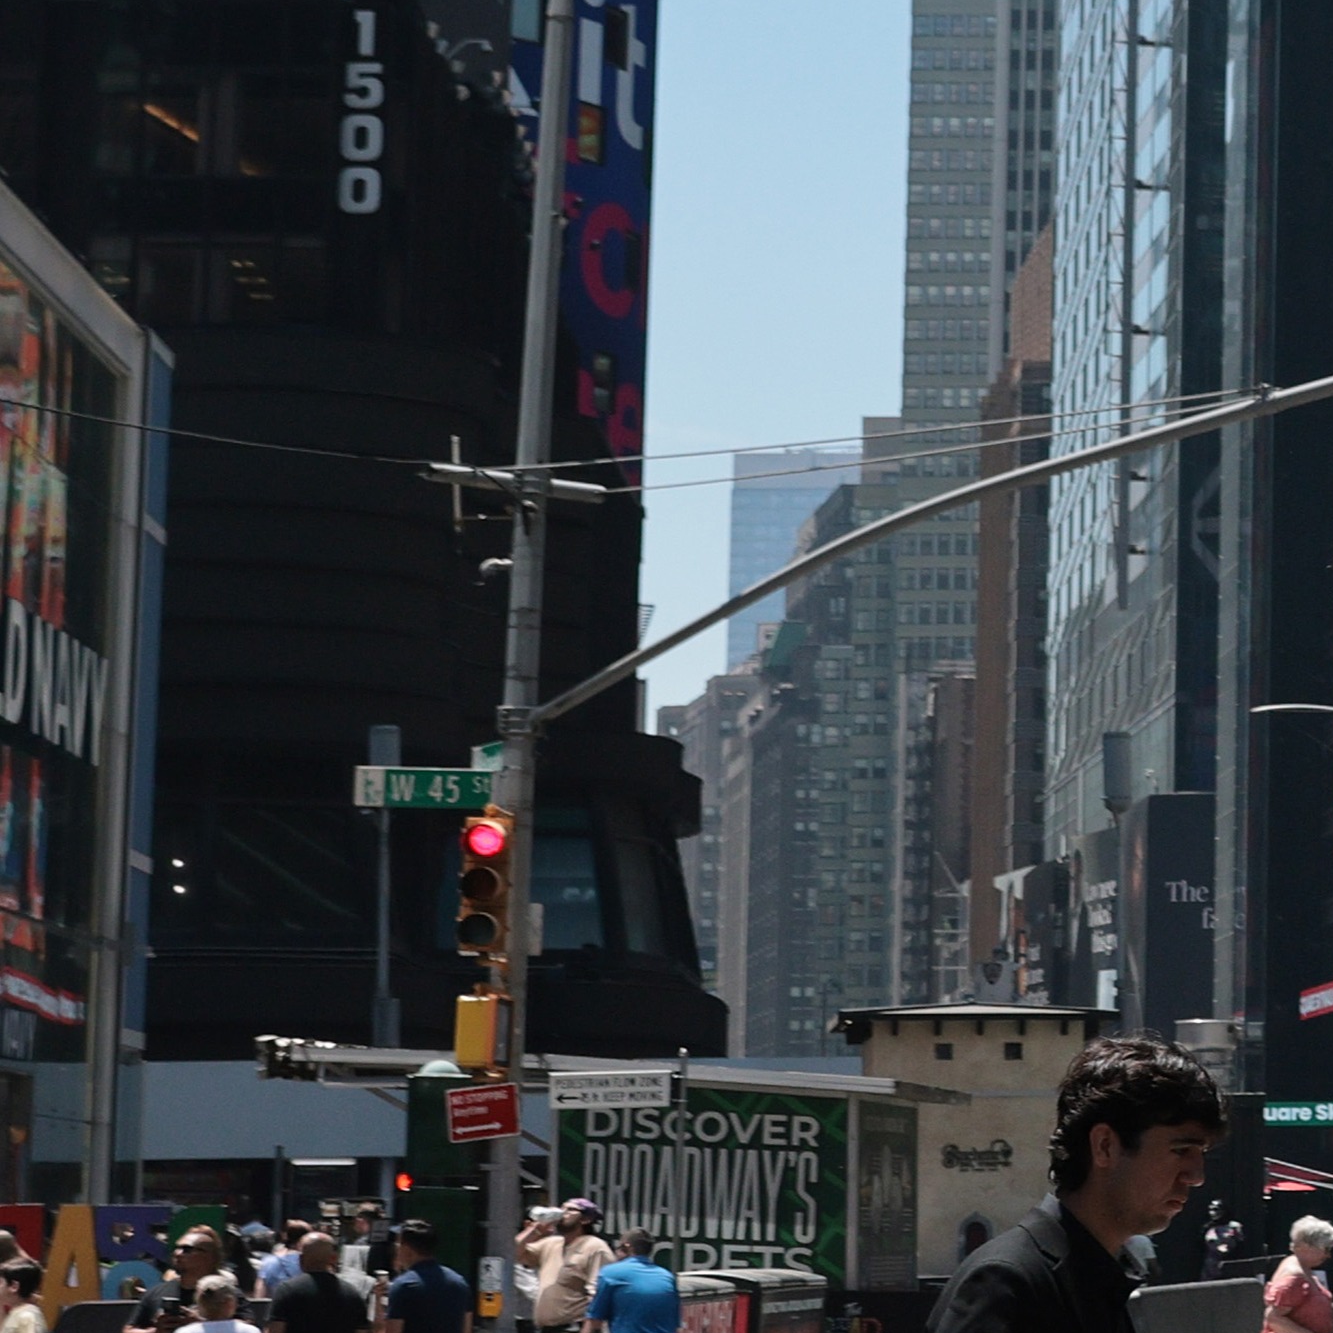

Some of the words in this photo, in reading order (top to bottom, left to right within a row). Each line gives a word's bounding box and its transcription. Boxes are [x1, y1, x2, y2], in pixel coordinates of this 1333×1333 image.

[337, 10, 386, 215] 1500
[31, 614, 109, 767] NAVY
[389, 773, 416, 802] W
[427, 774, 461, 804] 45
[471, 776, 493, 794] St
[1165, 879, 1210, 904] The
[585, 1107, 821, 1148] DISCOVER
[583, 1141, 820, 1245] BROADWAY'S
[649, 1240, 814, 1274] CRETS
